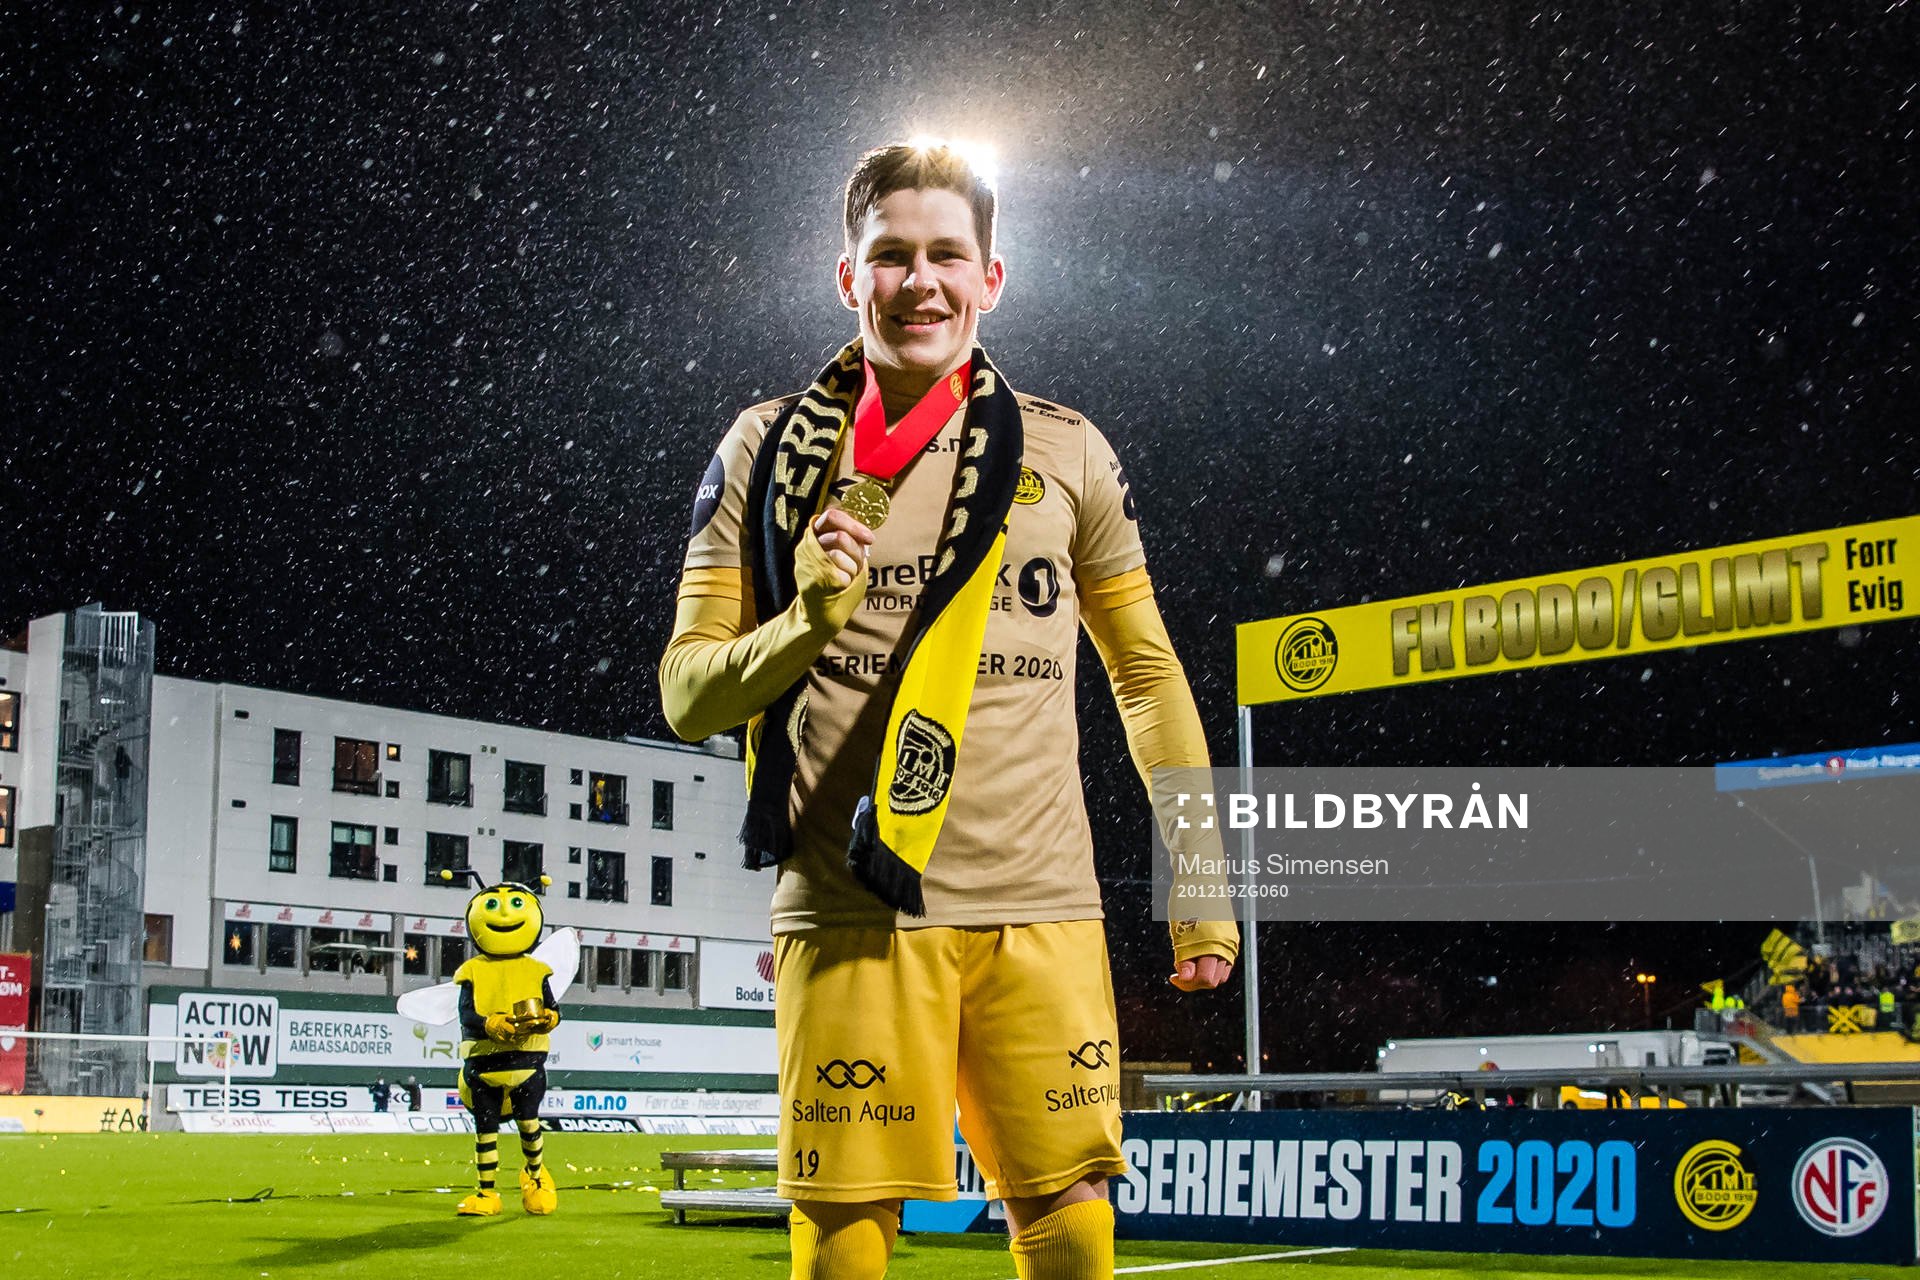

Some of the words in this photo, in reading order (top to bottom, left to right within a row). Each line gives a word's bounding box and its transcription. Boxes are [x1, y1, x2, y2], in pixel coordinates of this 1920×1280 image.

[1845, 538, 1897, 570] Førr
[1848, 576, 1903, 612] Evig
[1391, 600, 1456, 678] FK
[1463, 541, 1829, 668] BODØ/GLIMT
[1013, 655, 1064, 681] 2020
[185, 1000, 272, 1027] ACTION
[289, 1021, 393, 1040] BÆREKRAFTS-
[606, 1036, 634, 1047] smart
[637, 1036, 662, 1047] house
[289, 1039, 393, 1055] AMBASSADØRER
[183, 1089, 261, 1108] TESS
[275, 1090, 348, 1108] TESS
[574, 1094, 627, 1112] an.no
[558, 1118, 639, 1133] DIADORA
[792, 1098, 852, 1123] Salten
[859, 1100, 916, 1127] Aqua
[794, 1147, 820, 1178] 19
[1117, 1138, 1462, 1223] SERIEMESTER
[1477, 1139, 1637, 1228] 2020
